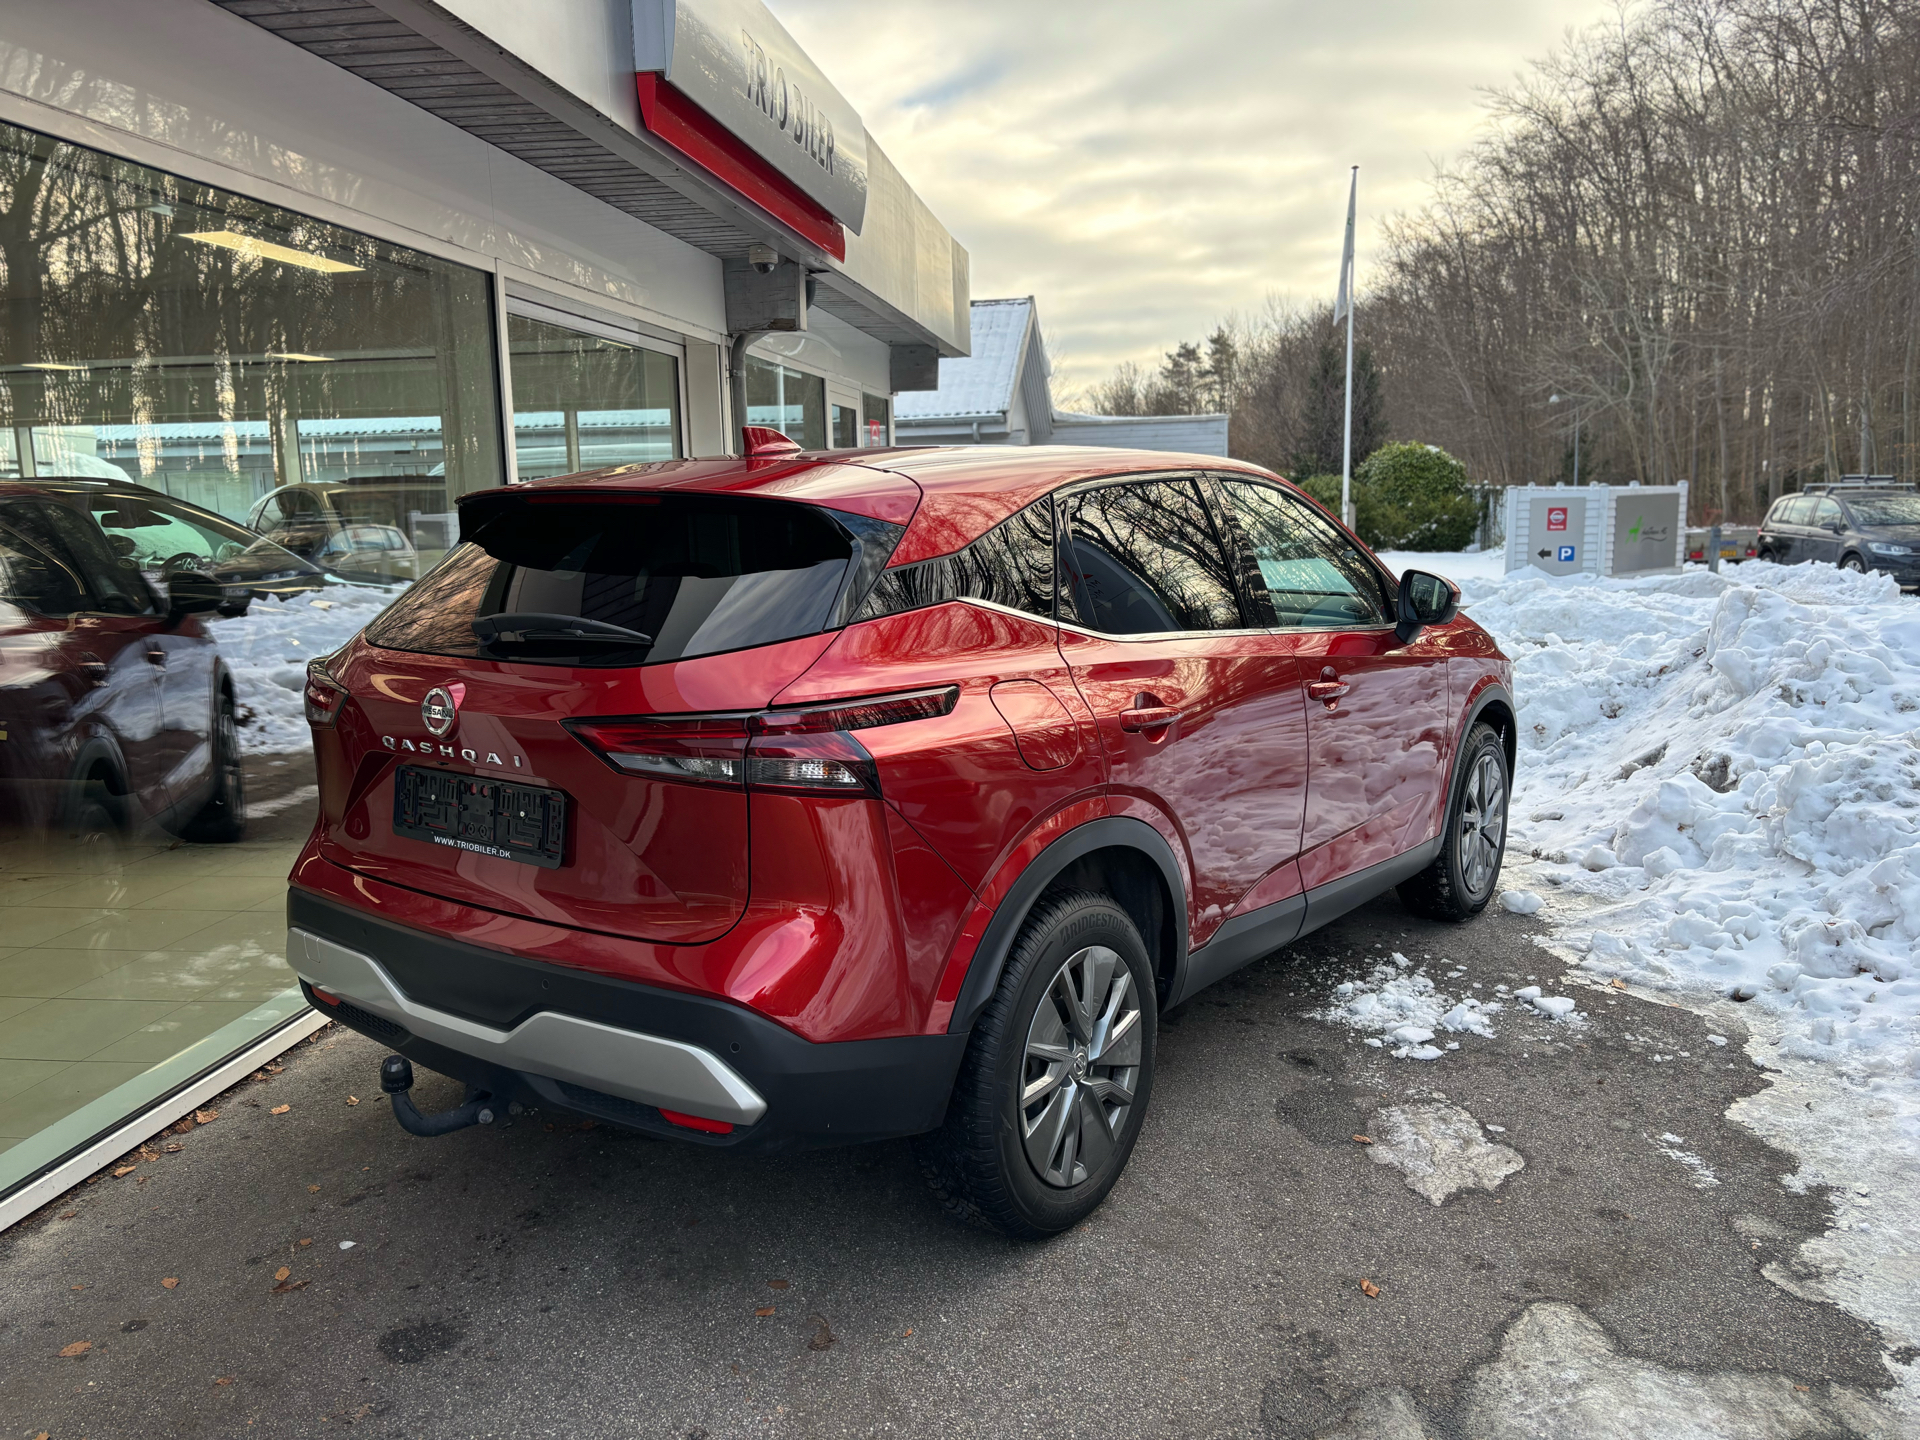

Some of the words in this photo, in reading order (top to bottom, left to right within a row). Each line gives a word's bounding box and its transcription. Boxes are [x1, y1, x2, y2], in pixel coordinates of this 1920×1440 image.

[742, 28, 788, 130] TRIO
[793, 83, 835, 177] BILER
[382, 735, 522, 768] QASHQAI
[434, 835, 511, 859] WWW.TRIOBILER.DK
[1060, 912, 1130, 945] BRIDGESTONE
